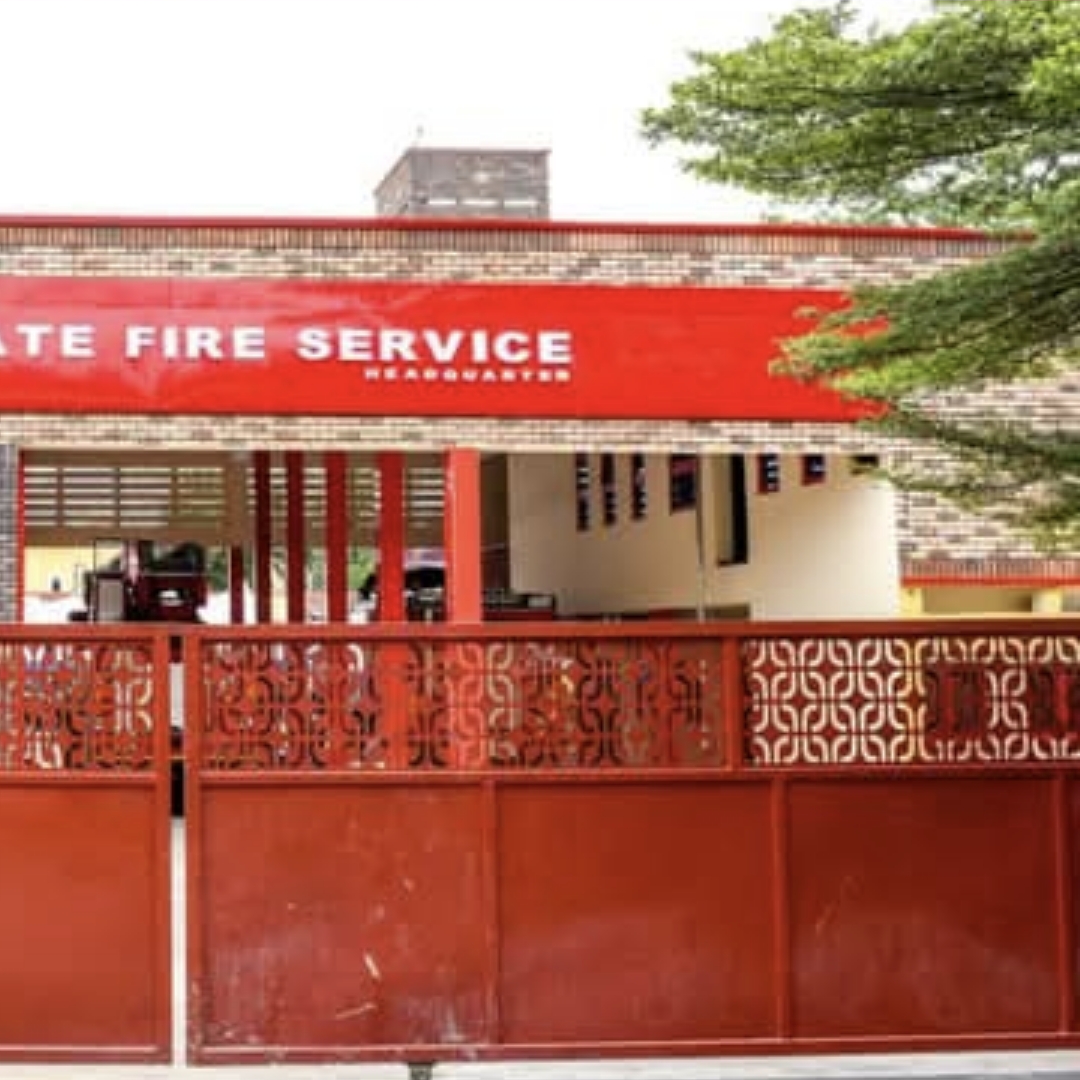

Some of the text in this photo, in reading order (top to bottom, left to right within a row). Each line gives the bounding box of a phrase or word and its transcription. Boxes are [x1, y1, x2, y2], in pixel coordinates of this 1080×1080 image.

[126, 324, 265, 359] FIRE
[296, 327, 572, 364] SERVICE
[364, 367, 571, 383] HEADQUARTER
